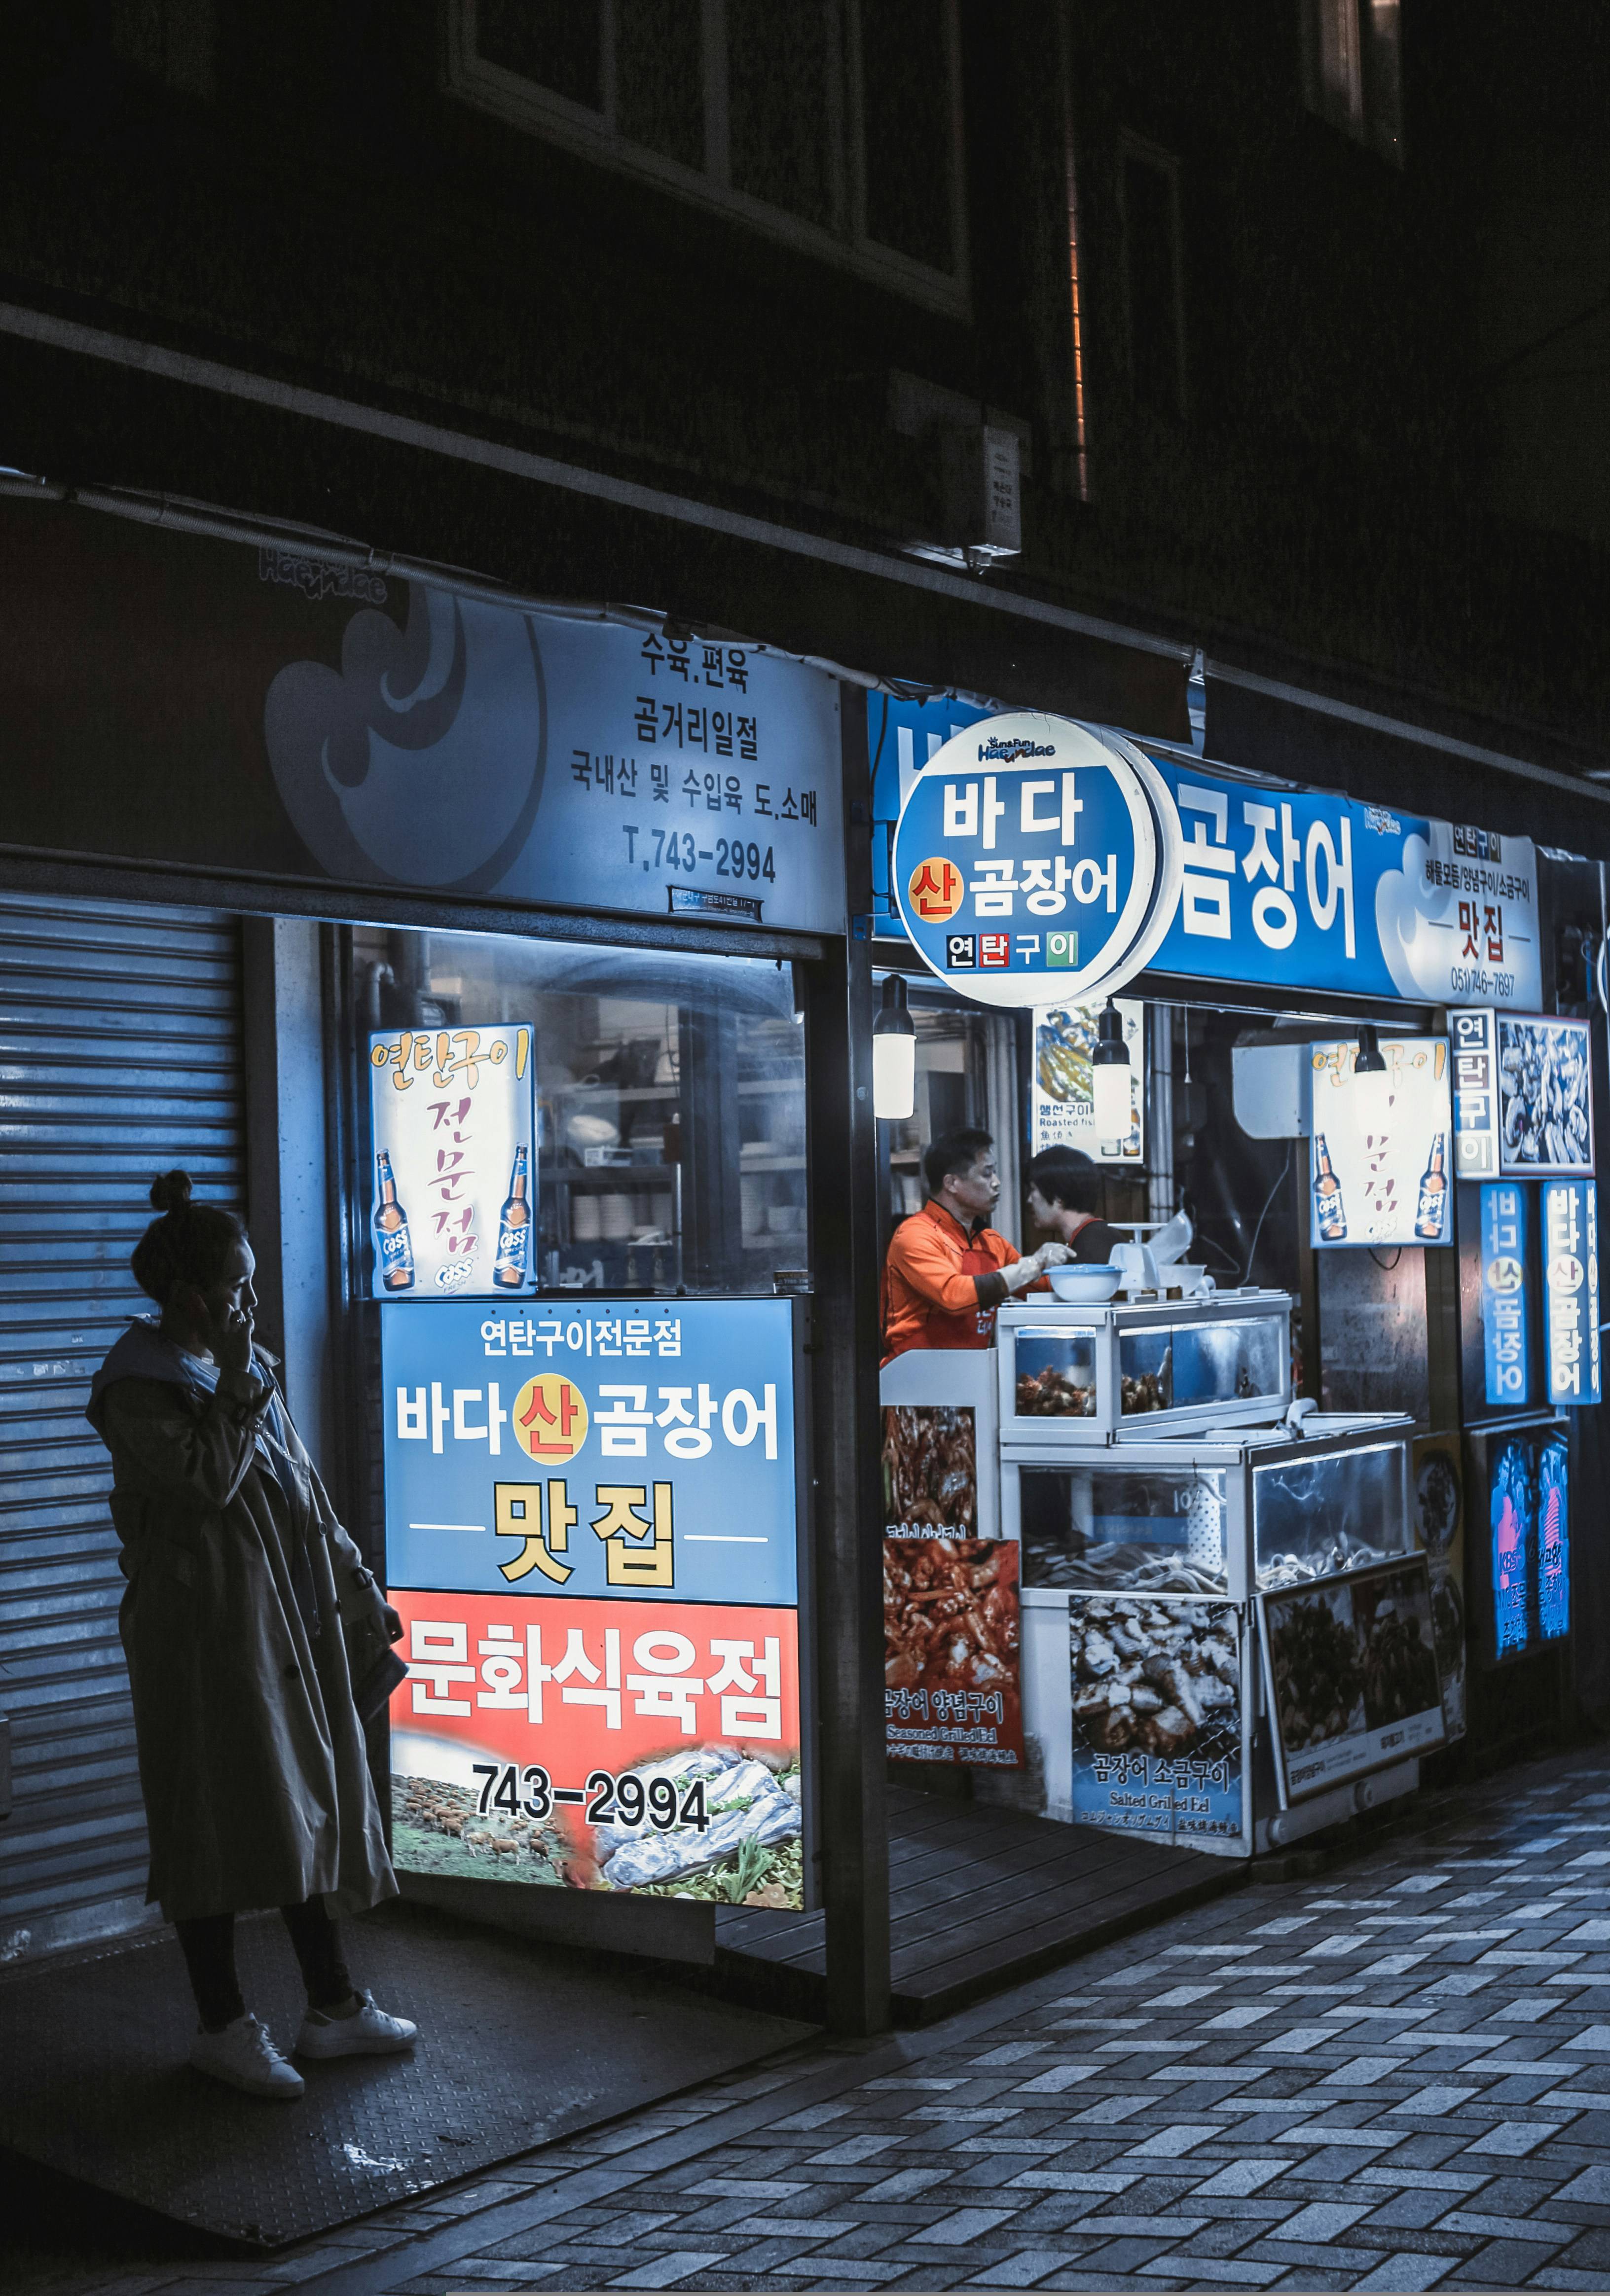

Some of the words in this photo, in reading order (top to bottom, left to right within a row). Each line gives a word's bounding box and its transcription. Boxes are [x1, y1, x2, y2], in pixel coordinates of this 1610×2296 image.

[641, 633, 749, 694] 수육.편육
[635, 696, 758, 761] 곰거리일절
[978, 741, 1057, 763] Haeundae
[571, 750, 637, 798] 국내산
[650, 763, 669, 803] 및
[682, 770, 742, 815] 수입육
[755, 784, 818, 827] 도.소매
[622, 825, 776, 884] T.743-2994
[1455, 825, 1500, 860] 연탄구이
[949, 933, 1074, 967] 연탄구이
[1459, 900, 1504, 962] 맛집
[371, 1029, 530, 1090] 연탄구이
[1312, 1042, 1446, 1087] 연구이
[1457, 1016, 1487, 1169] 연탄구이
[1040, 1118, 1078, 1127] Roasted
[1081, 1118, 1095, 1127] fis
[427, 1097, 476, 1255] 전문점
[480, 1318, 682, 1357] 연탄구이전문점
[494, 1477, 675, 1589] 맛집
[405, 1620, 782, 1740] 문화식육점
[931, 1689, 1004, 1724] 양념구이
[886, 1724, 939, 1742] Seasoned
[940, 1726, 977, 1743] Grilled
[473, 1762, 712, 1835] 743-2994
[1093, 1753, 1149, 1788] 곰장어
[1153, 1758, 1229, 1794] 소금구이
[1109, 1791, 1147, 1808] Salted
[1190, 1796, 1211, 1814] Eel
